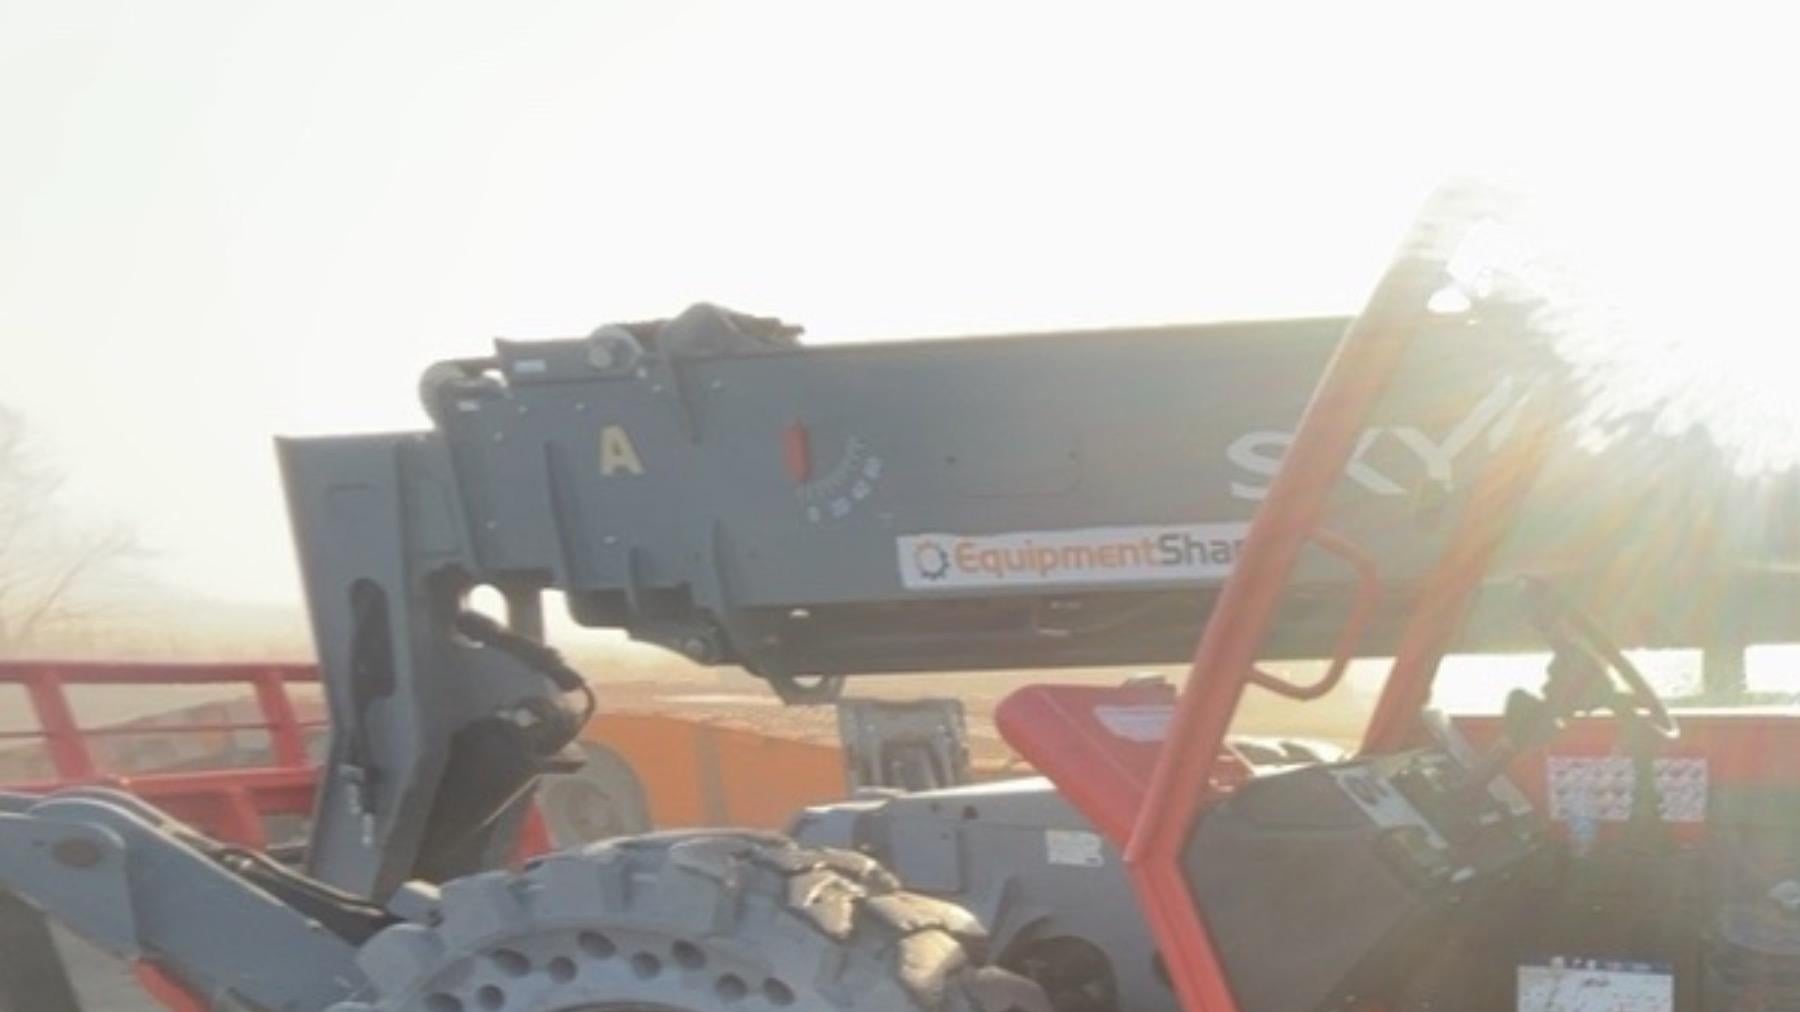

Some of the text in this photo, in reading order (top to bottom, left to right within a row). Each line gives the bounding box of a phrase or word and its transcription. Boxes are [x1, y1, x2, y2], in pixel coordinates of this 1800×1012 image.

[602, 424, 645, 477] A
[1226, 376, 1545, 500] SKY
[955, 532, 1247, 577] EquipmentShar
